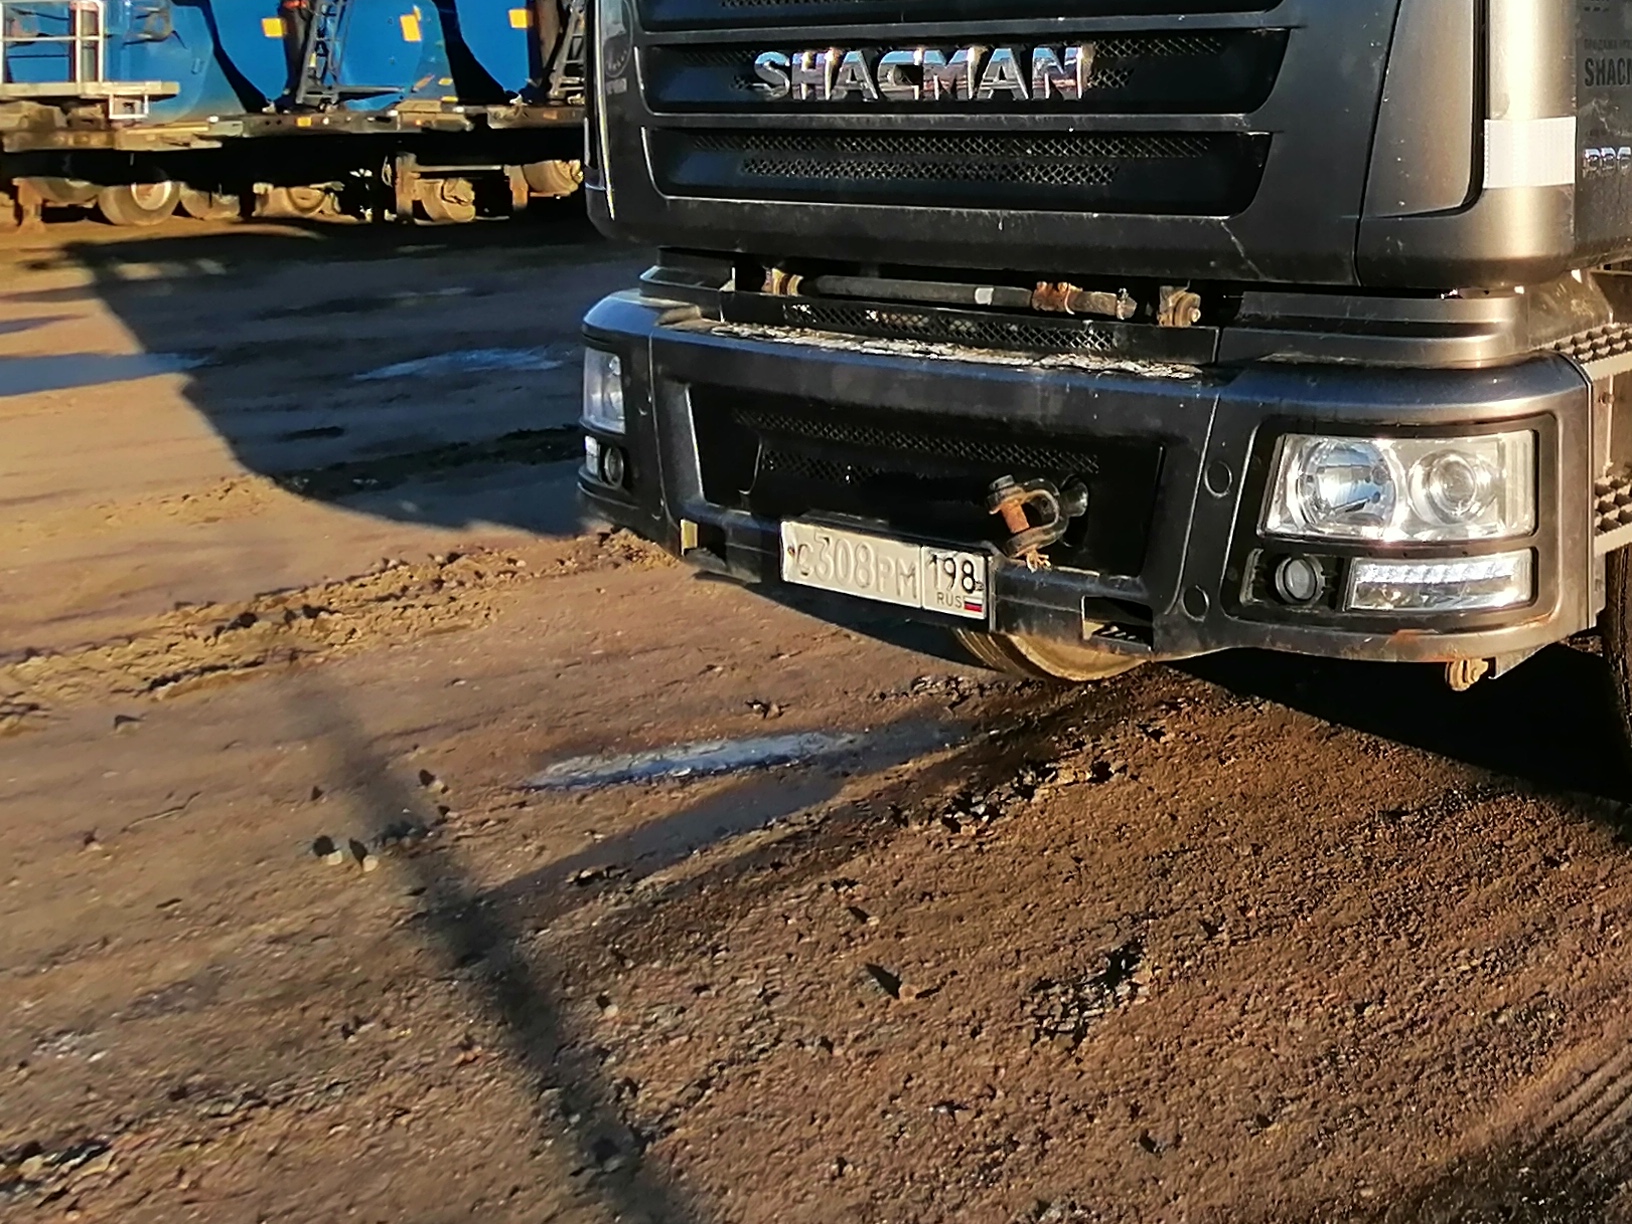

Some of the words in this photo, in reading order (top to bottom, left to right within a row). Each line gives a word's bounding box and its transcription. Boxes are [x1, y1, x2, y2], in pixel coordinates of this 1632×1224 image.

[754, 46, 1086, 102] SHACMAN
[927, 553, 976, 594] 198
[936, 591, 964, 609] RUS
